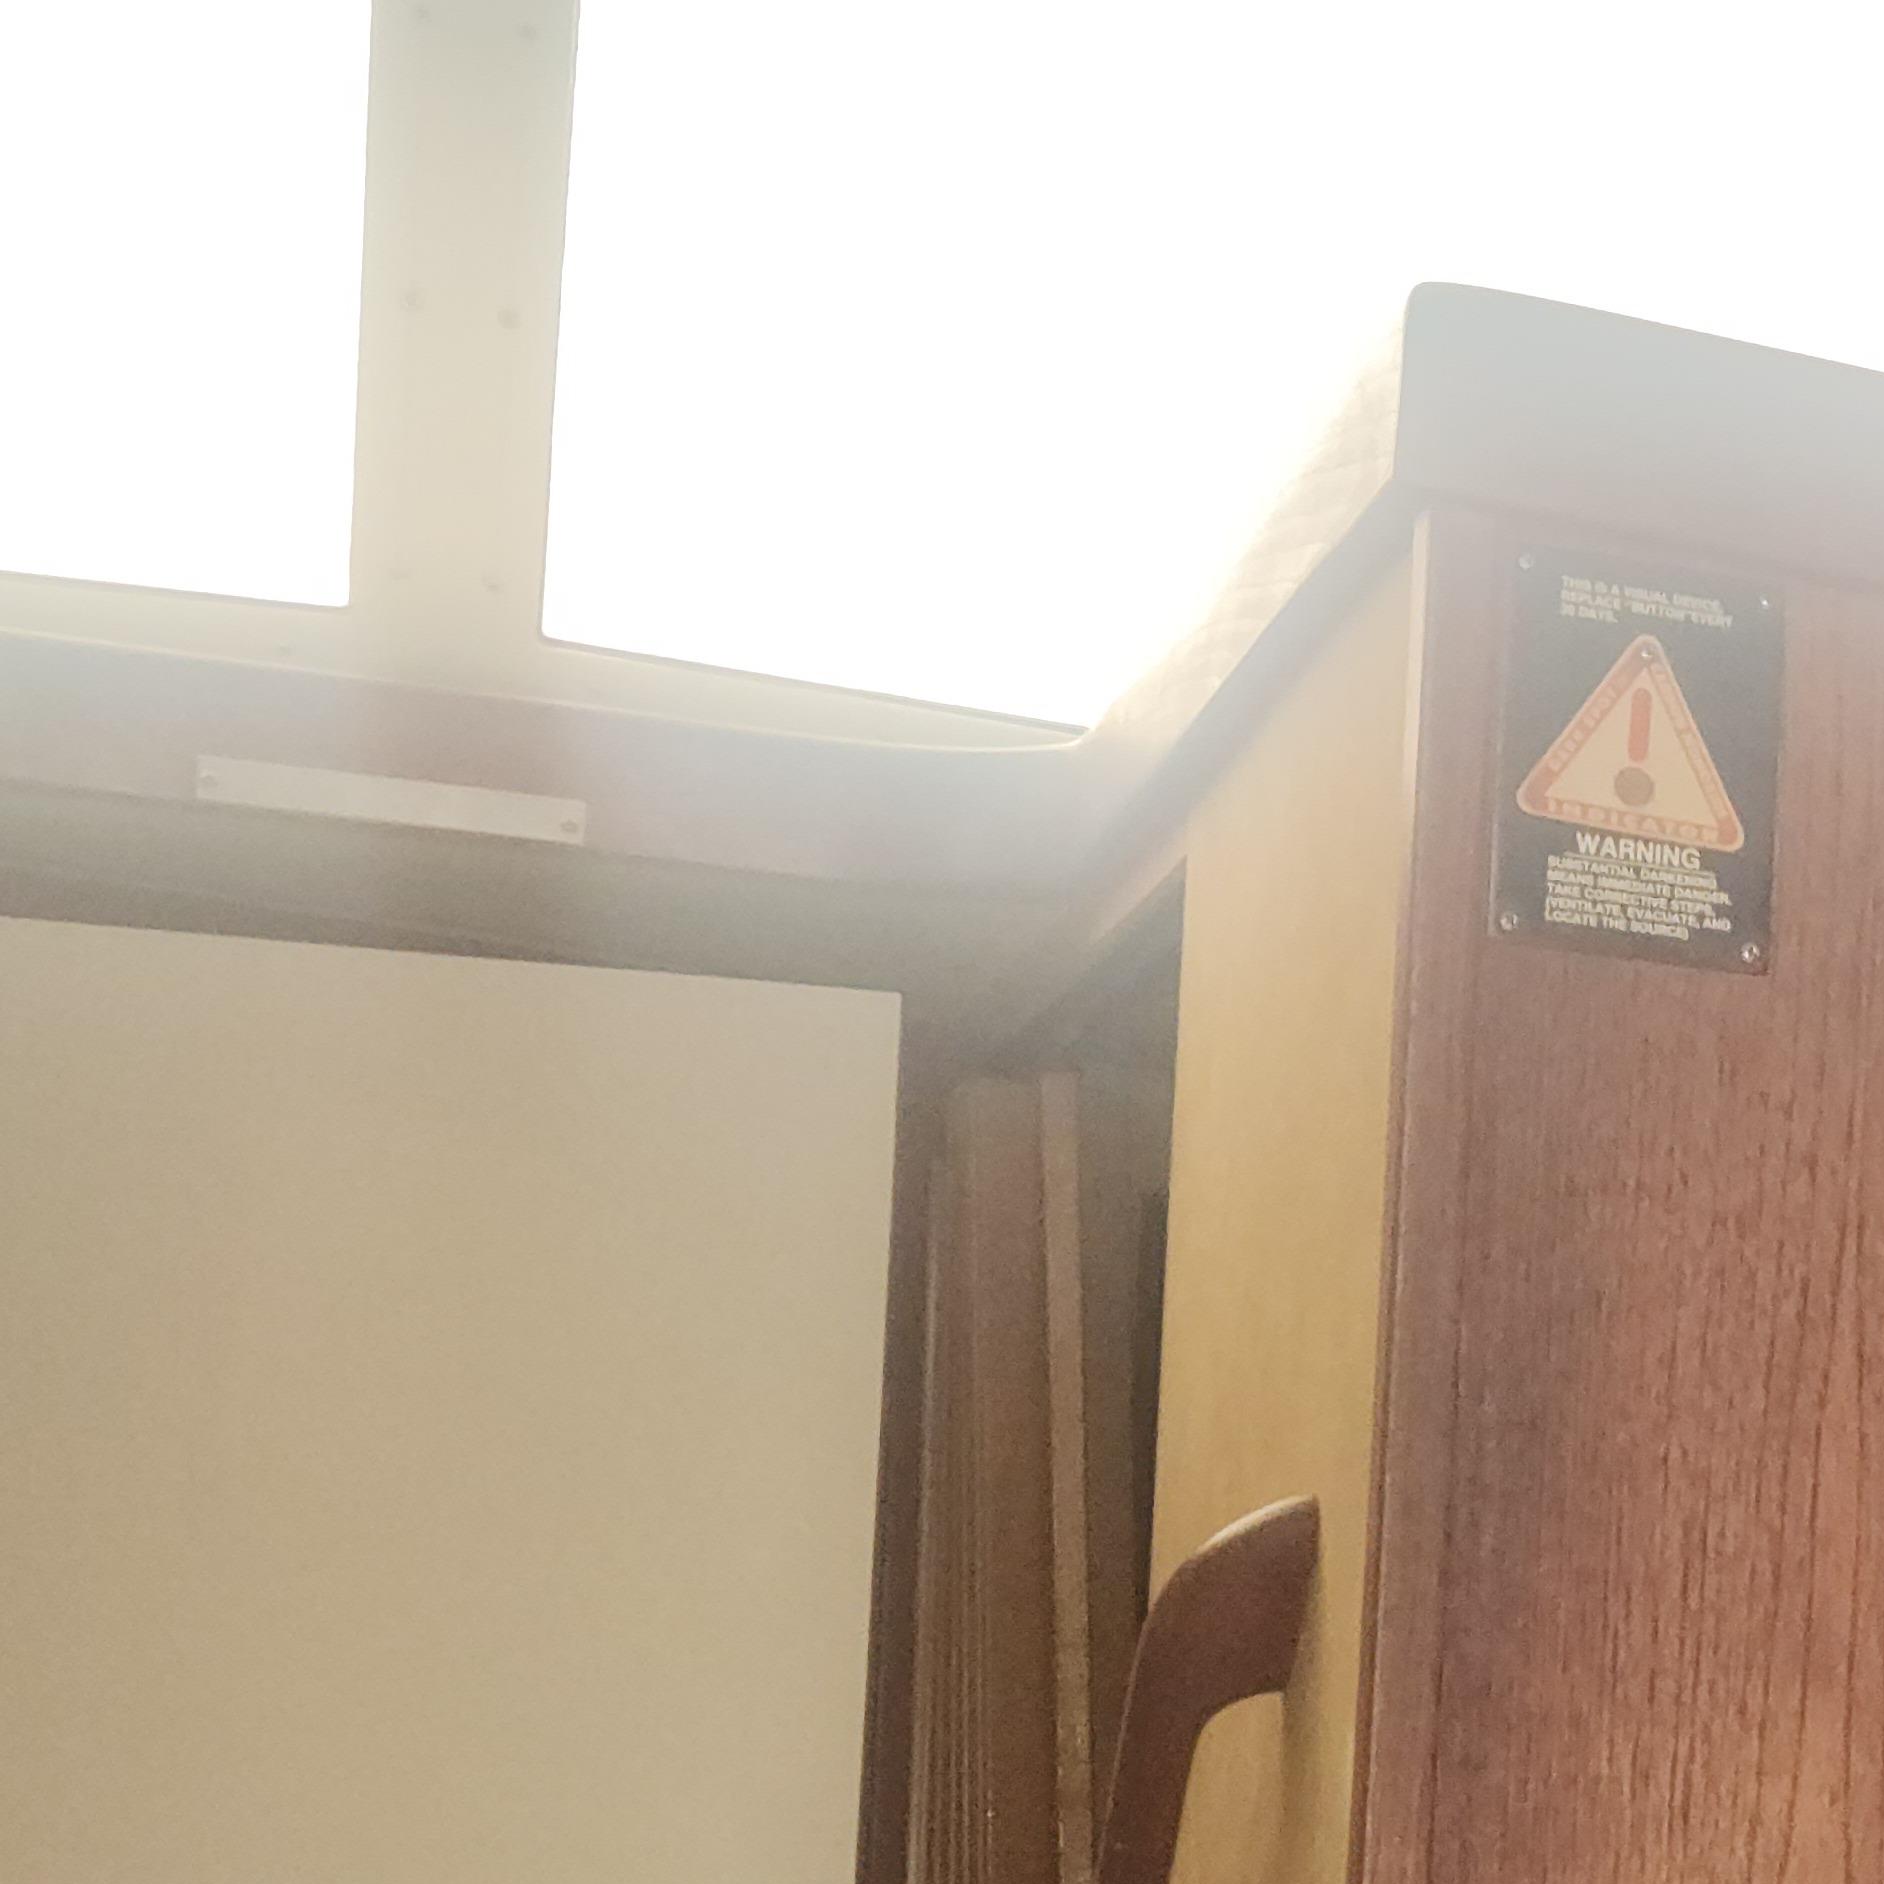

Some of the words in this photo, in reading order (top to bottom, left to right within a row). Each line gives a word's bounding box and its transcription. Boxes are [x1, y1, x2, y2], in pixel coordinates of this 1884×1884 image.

[1611, 584, 1619, 595] A
[1576, 831, 1701, 870] WARNING
[1548, 855, 1636, 878] SUBSTANTIAL
[1547, 869, 1594, 886] MEANS
[1597, 875, 1671, 897] IMMEDIATE
[1548, 882, 1581, 898] TAKE
[1584, 887, 1668, 909] CORRECTIVE
[1603, 916, 1627, 931] THE
[1702, 917, 1732, 933] AND
